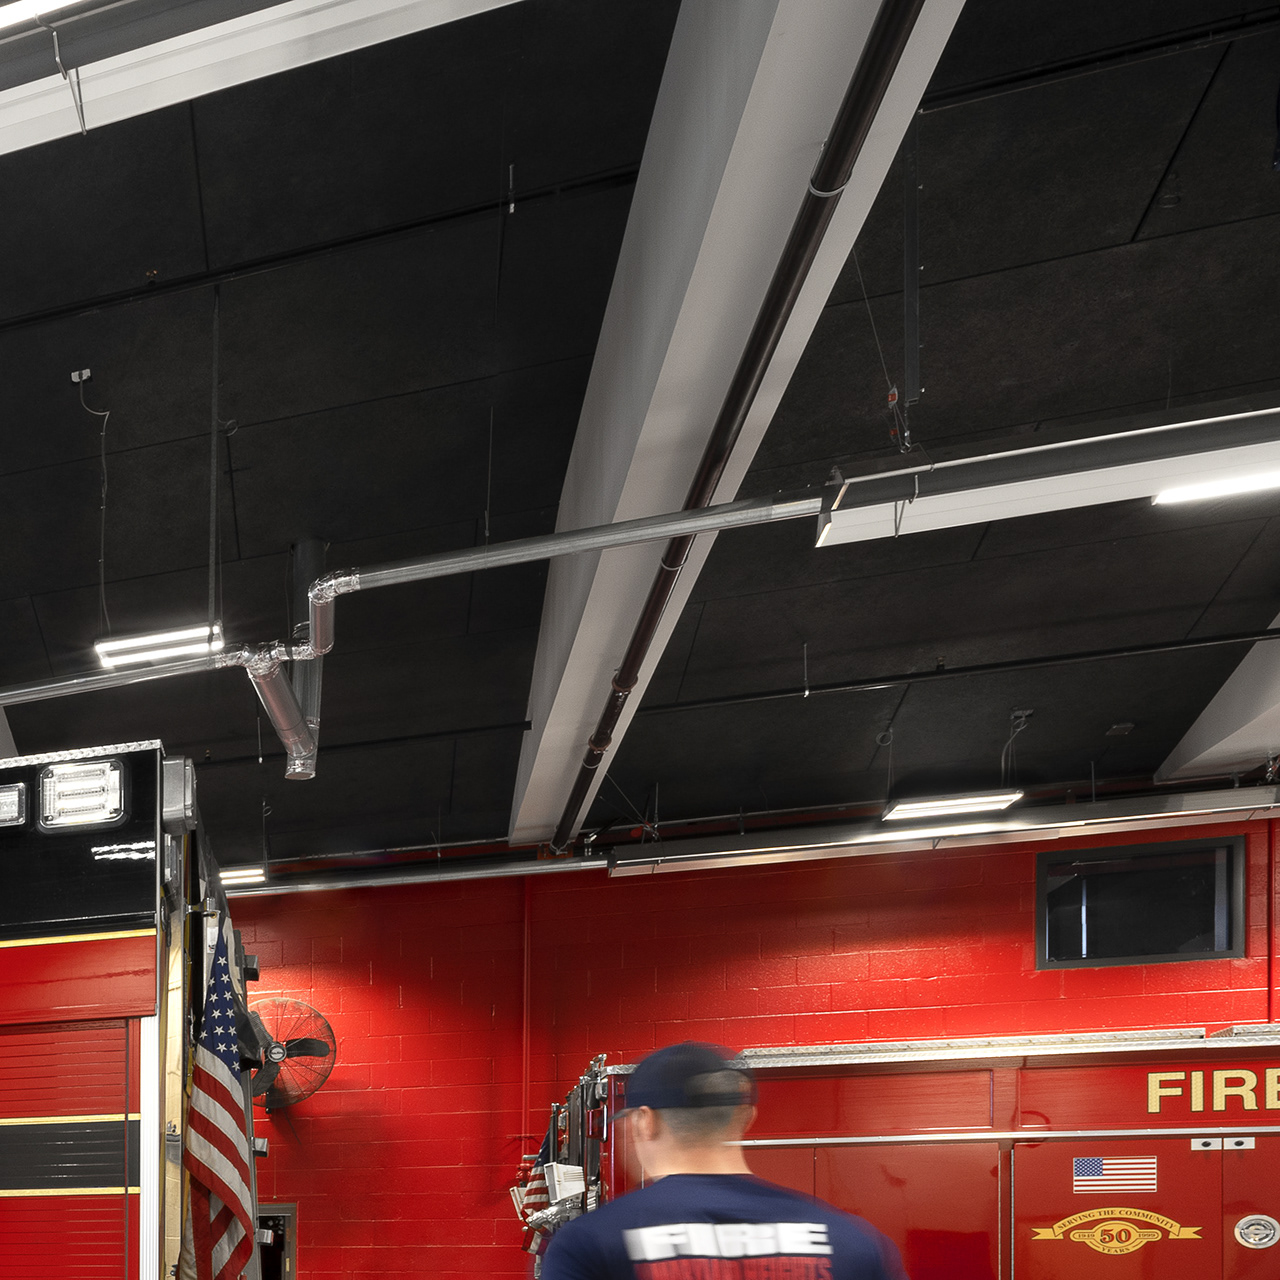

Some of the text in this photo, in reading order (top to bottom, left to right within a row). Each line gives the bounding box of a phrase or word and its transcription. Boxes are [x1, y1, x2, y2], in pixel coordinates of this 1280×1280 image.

[1057, 1212, 1096, 1230] SERVING
[1118, 1209, 1177, 1230] COMMUNITY
[624, 1222, 833, 1260] FIRE
[1100, 1228, 1132, 1244] 50
